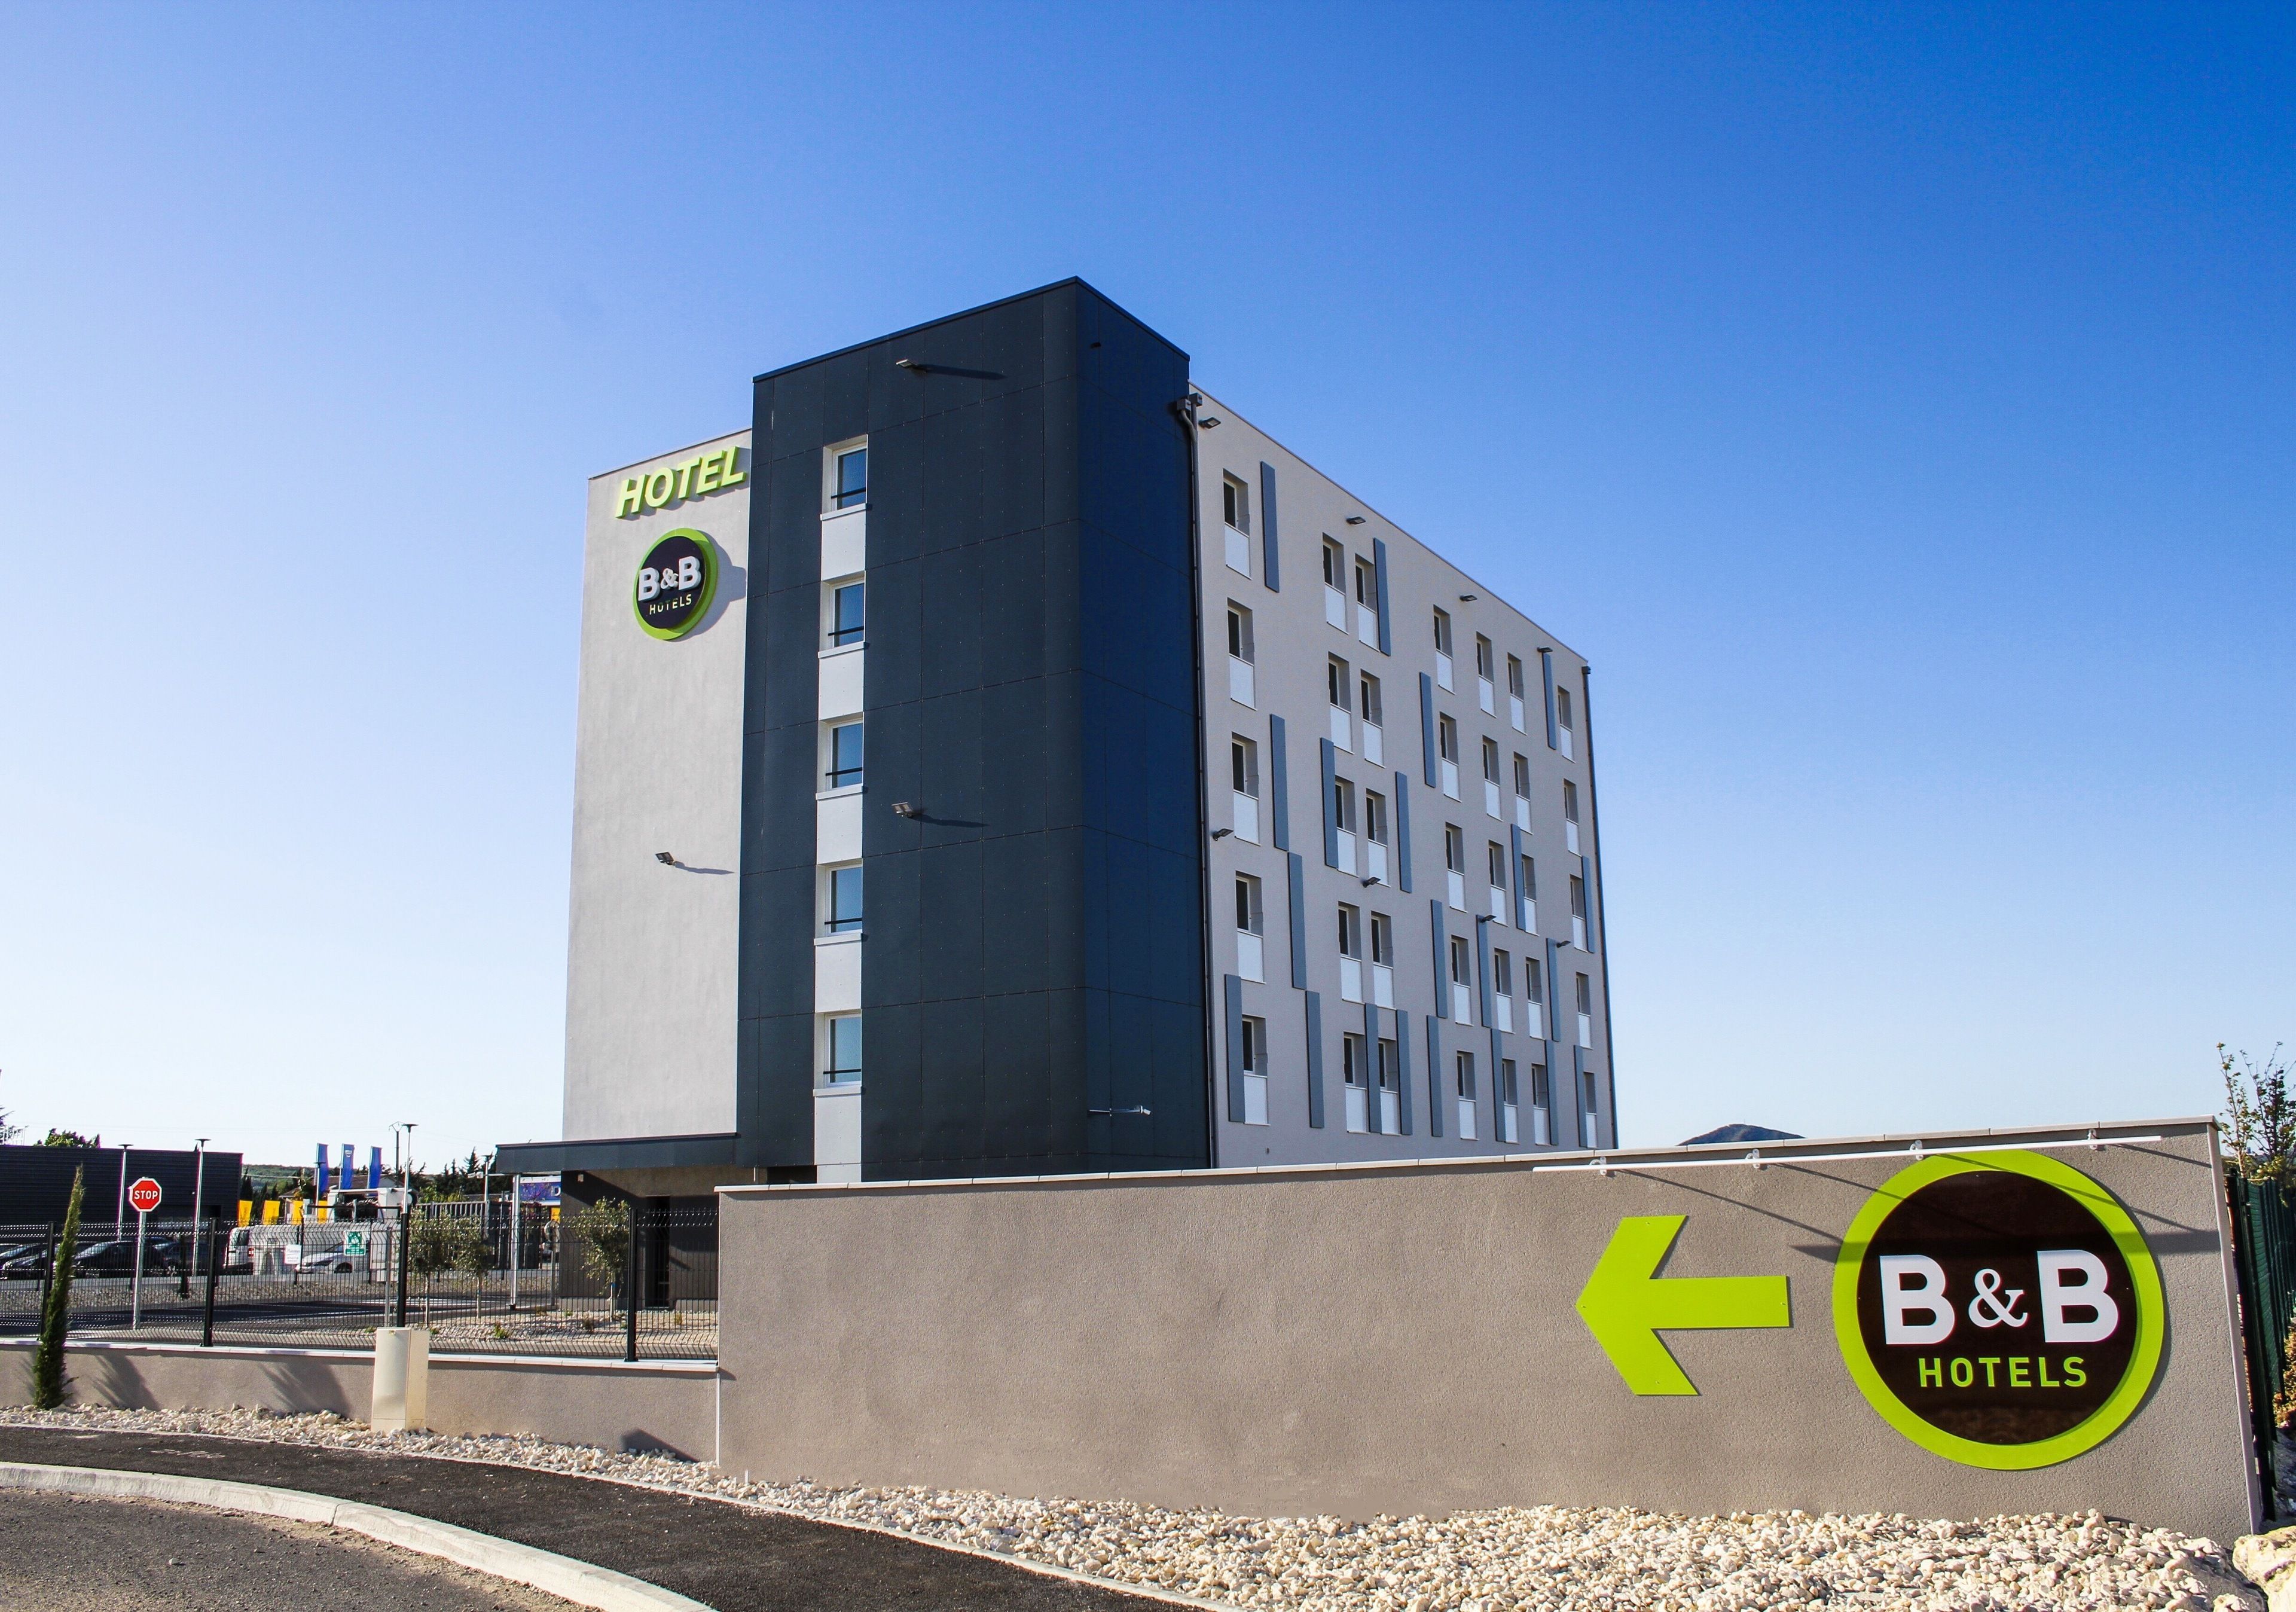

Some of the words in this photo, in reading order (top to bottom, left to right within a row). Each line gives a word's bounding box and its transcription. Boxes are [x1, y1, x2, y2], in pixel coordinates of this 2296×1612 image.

[615, 446, 747, 518] HOTEL
[638, 555, 701, 601] B&B
[649, 594, 692, 615] HOTELS
[134, 1190, 158, 1199] STOP
[1879, 1249, 2118, 1345] B&B
[1918, 1356, 2087, 1387] HOTELS
